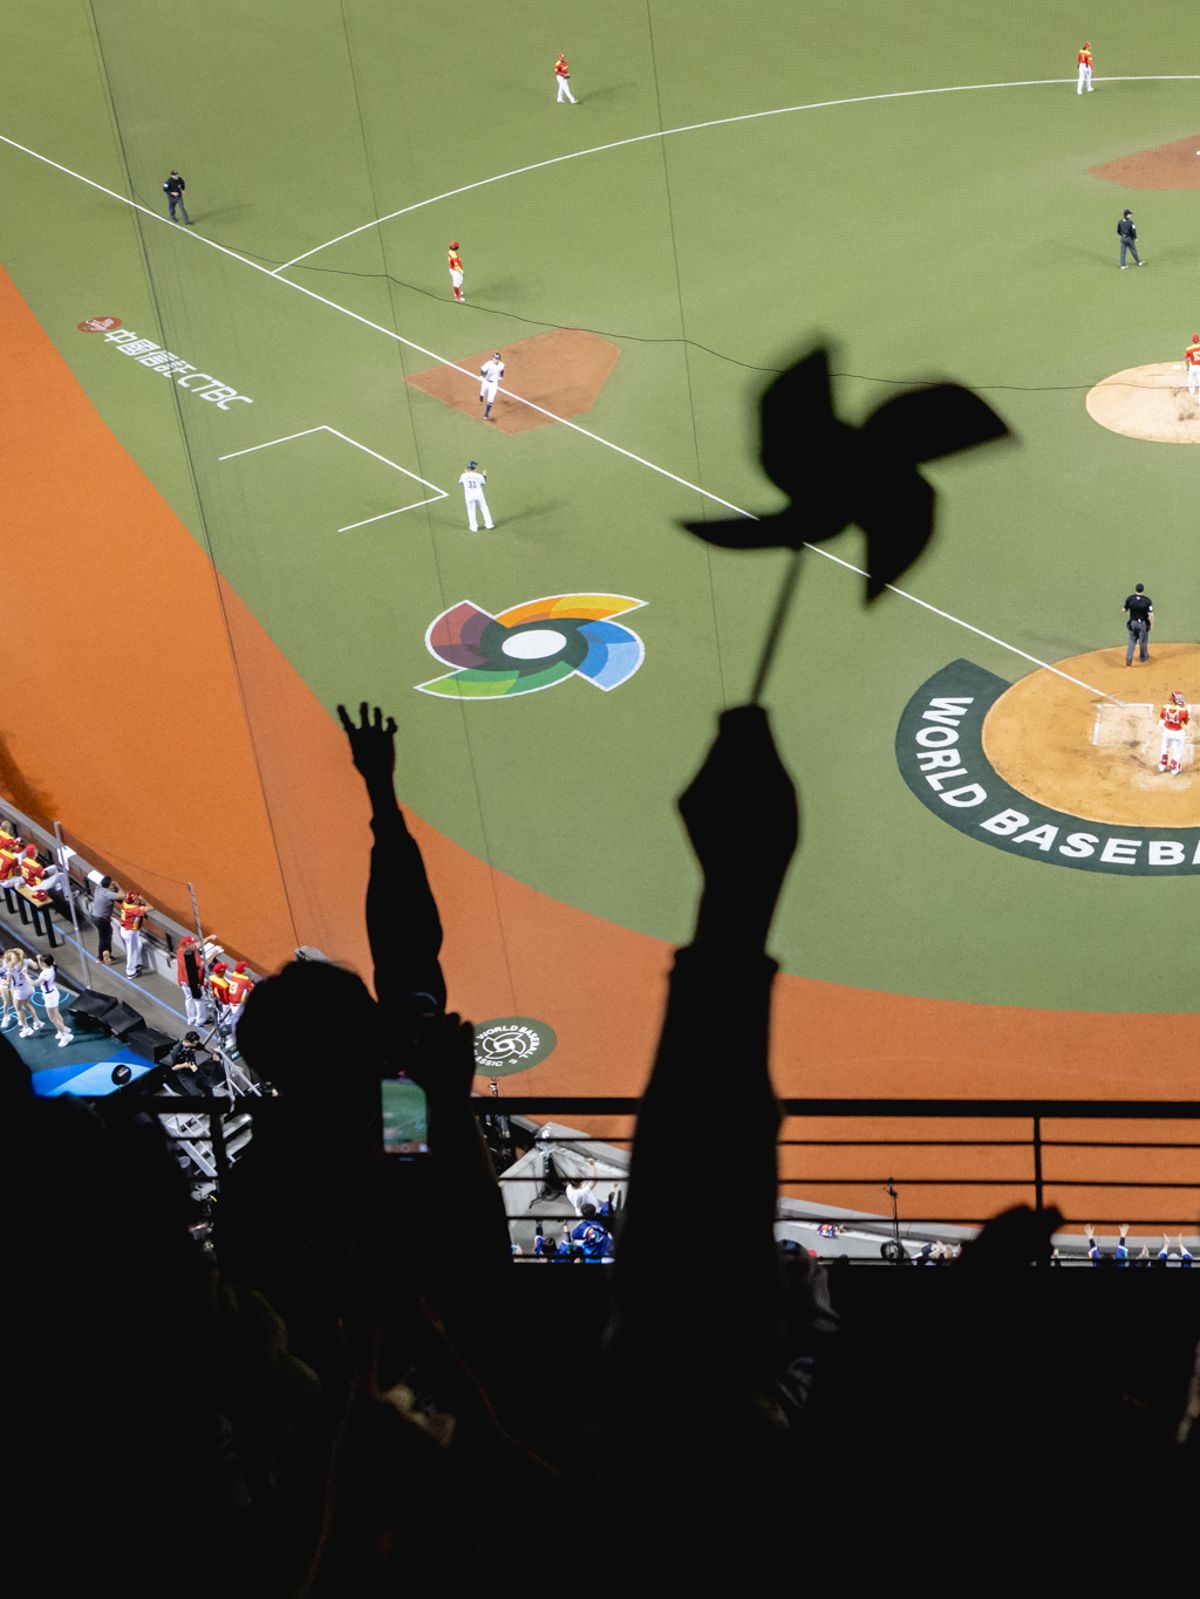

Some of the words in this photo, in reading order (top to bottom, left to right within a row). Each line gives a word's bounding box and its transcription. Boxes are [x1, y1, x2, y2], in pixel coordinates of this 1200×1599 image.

[177, 373, 254, 410] CTBC
[914, 696, 988, 809] WORLD
[476, 1024, 519, 1040] WORLD
